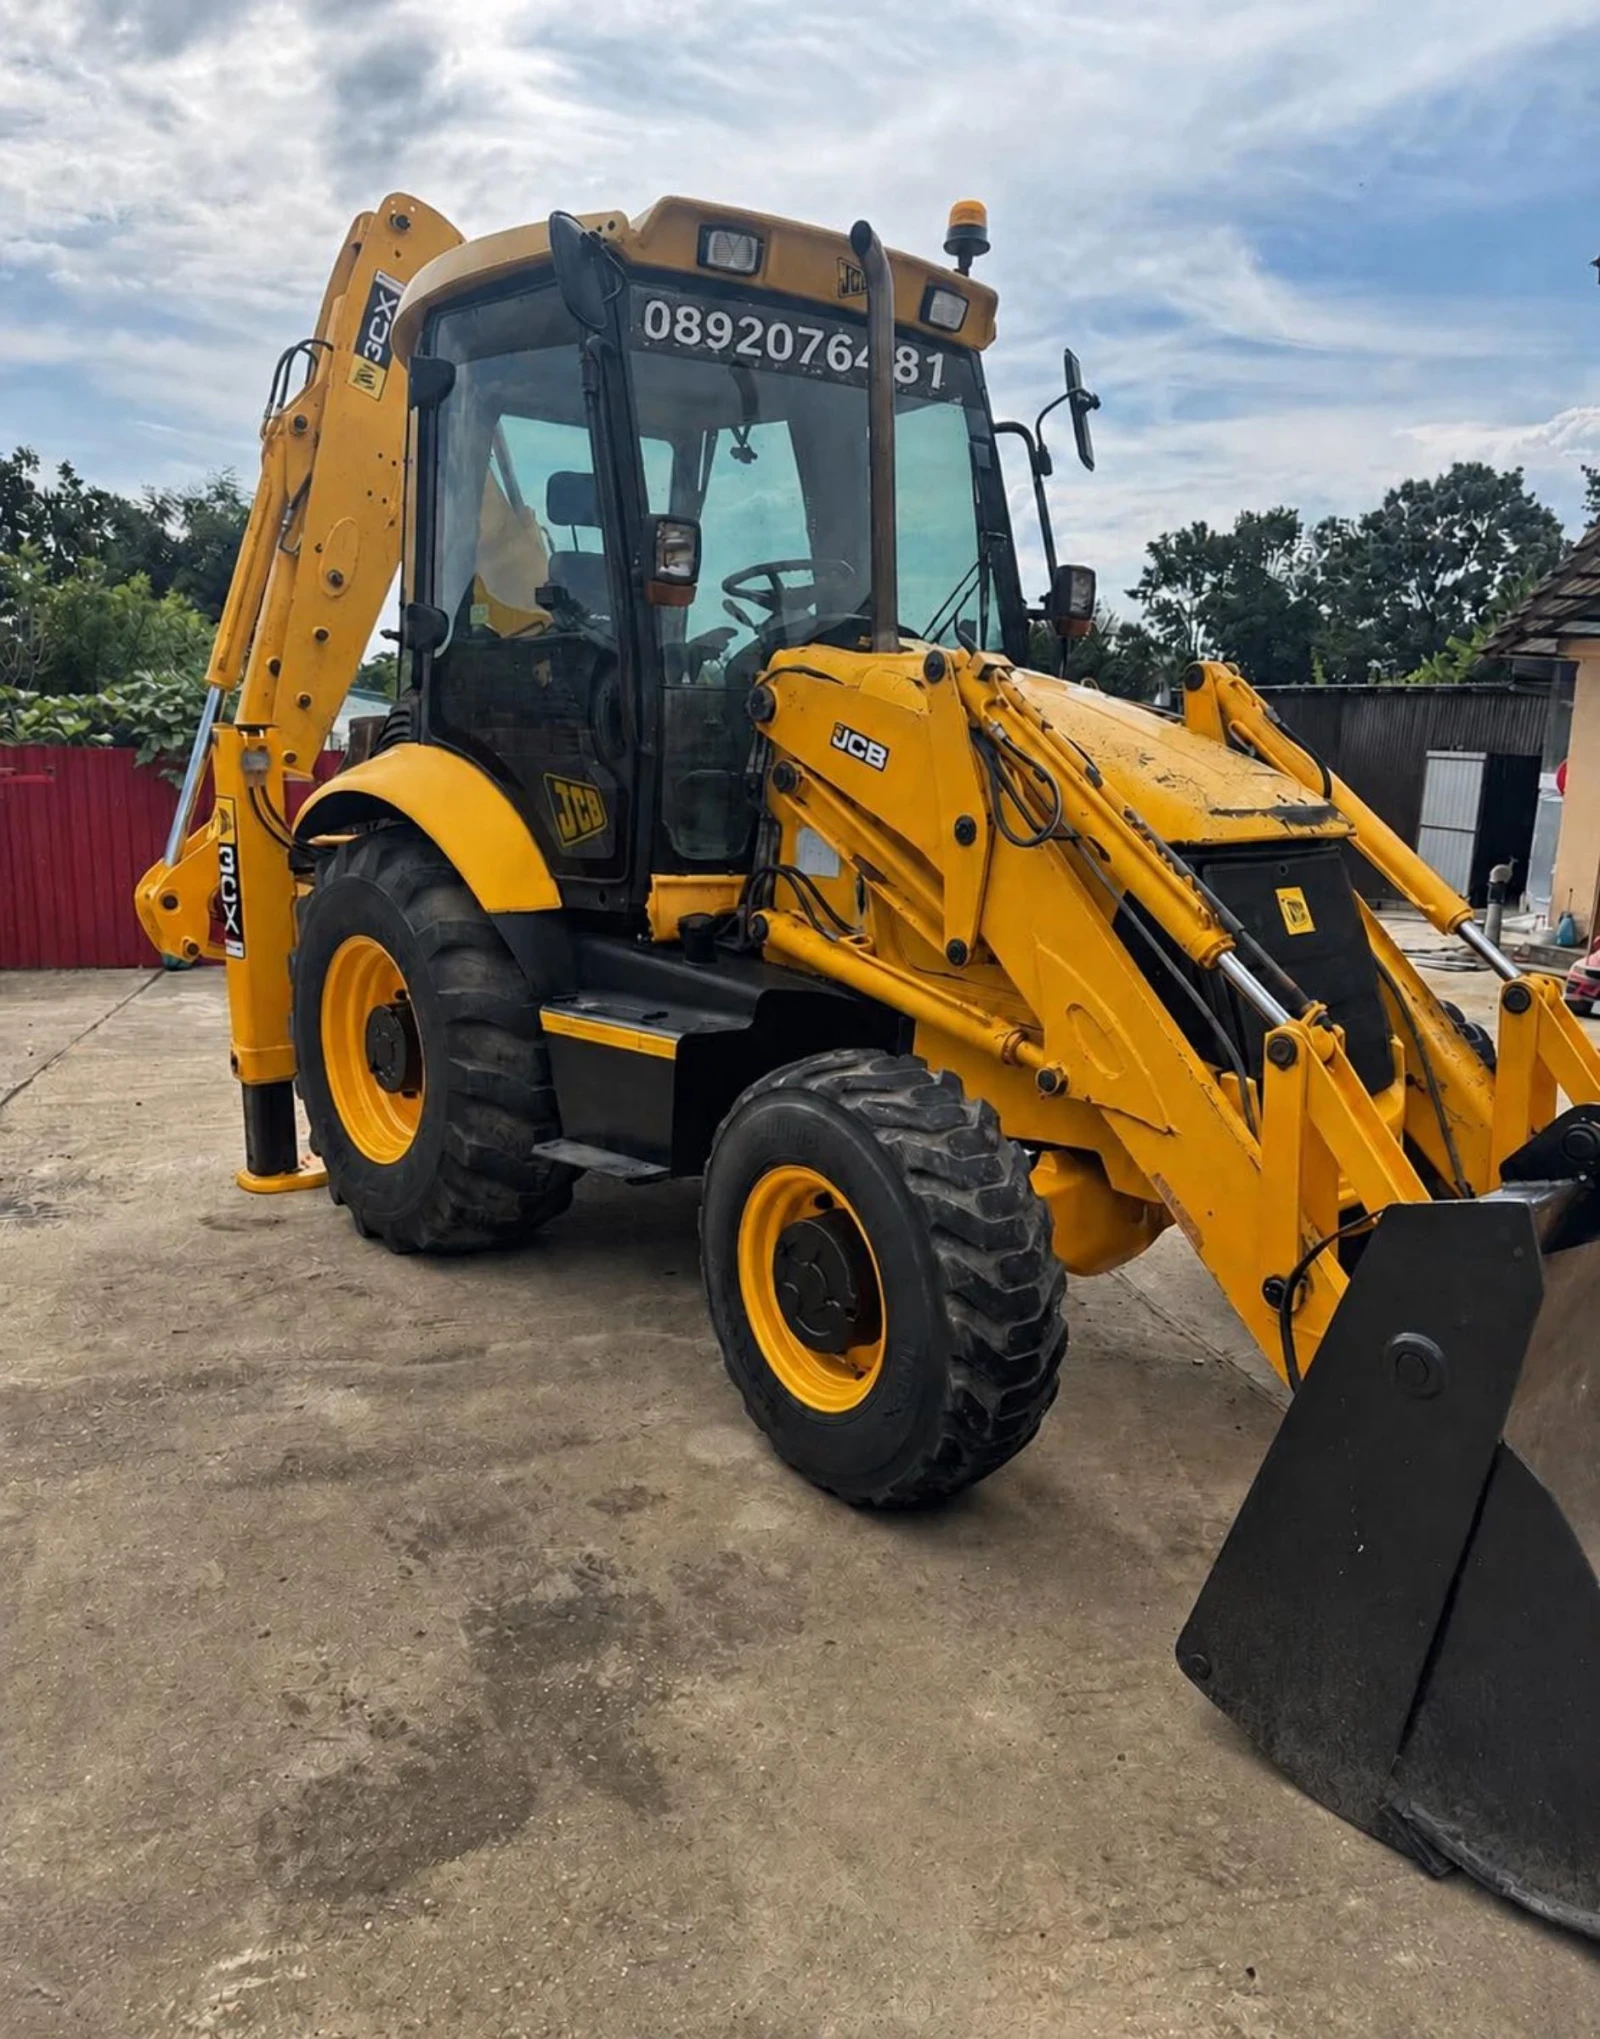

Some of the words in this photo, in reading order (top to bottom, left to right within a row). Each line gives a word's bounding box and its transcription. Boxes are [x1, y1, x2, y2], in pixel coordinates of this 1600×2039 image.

[364, 290, 398, 362] 3CX
[832, 729, 887, 769] JCB
[553, 780, 604, 839] JCB
[218, 846, 240, 934] 3CX
